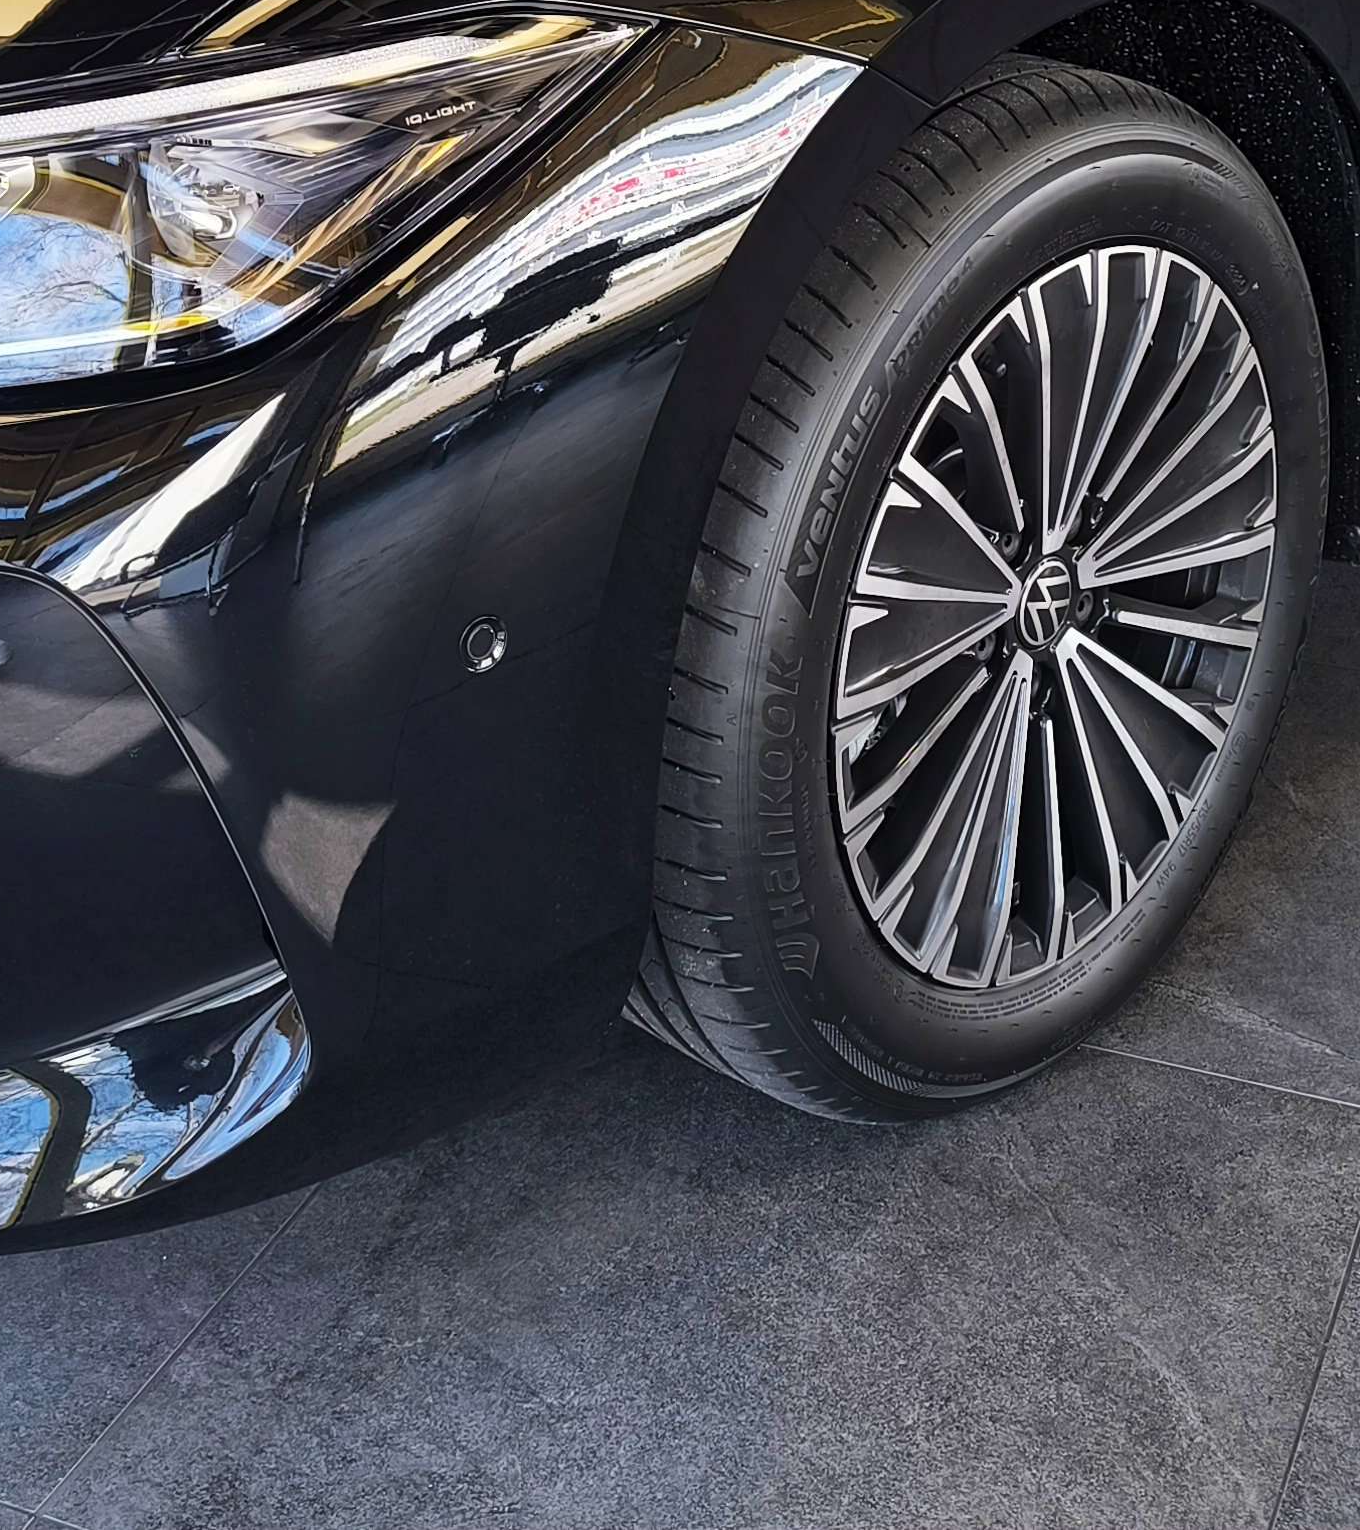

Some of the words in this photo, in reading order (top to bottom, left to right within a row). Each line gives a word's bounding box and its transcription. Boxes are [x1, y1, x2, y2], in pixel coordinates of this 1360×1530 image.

[405, 101, 476, 126] IQ.LIGHT
[1177, 798, 1213, 858] 215/55R17
[1155, 860, 1178, 891] 94W
